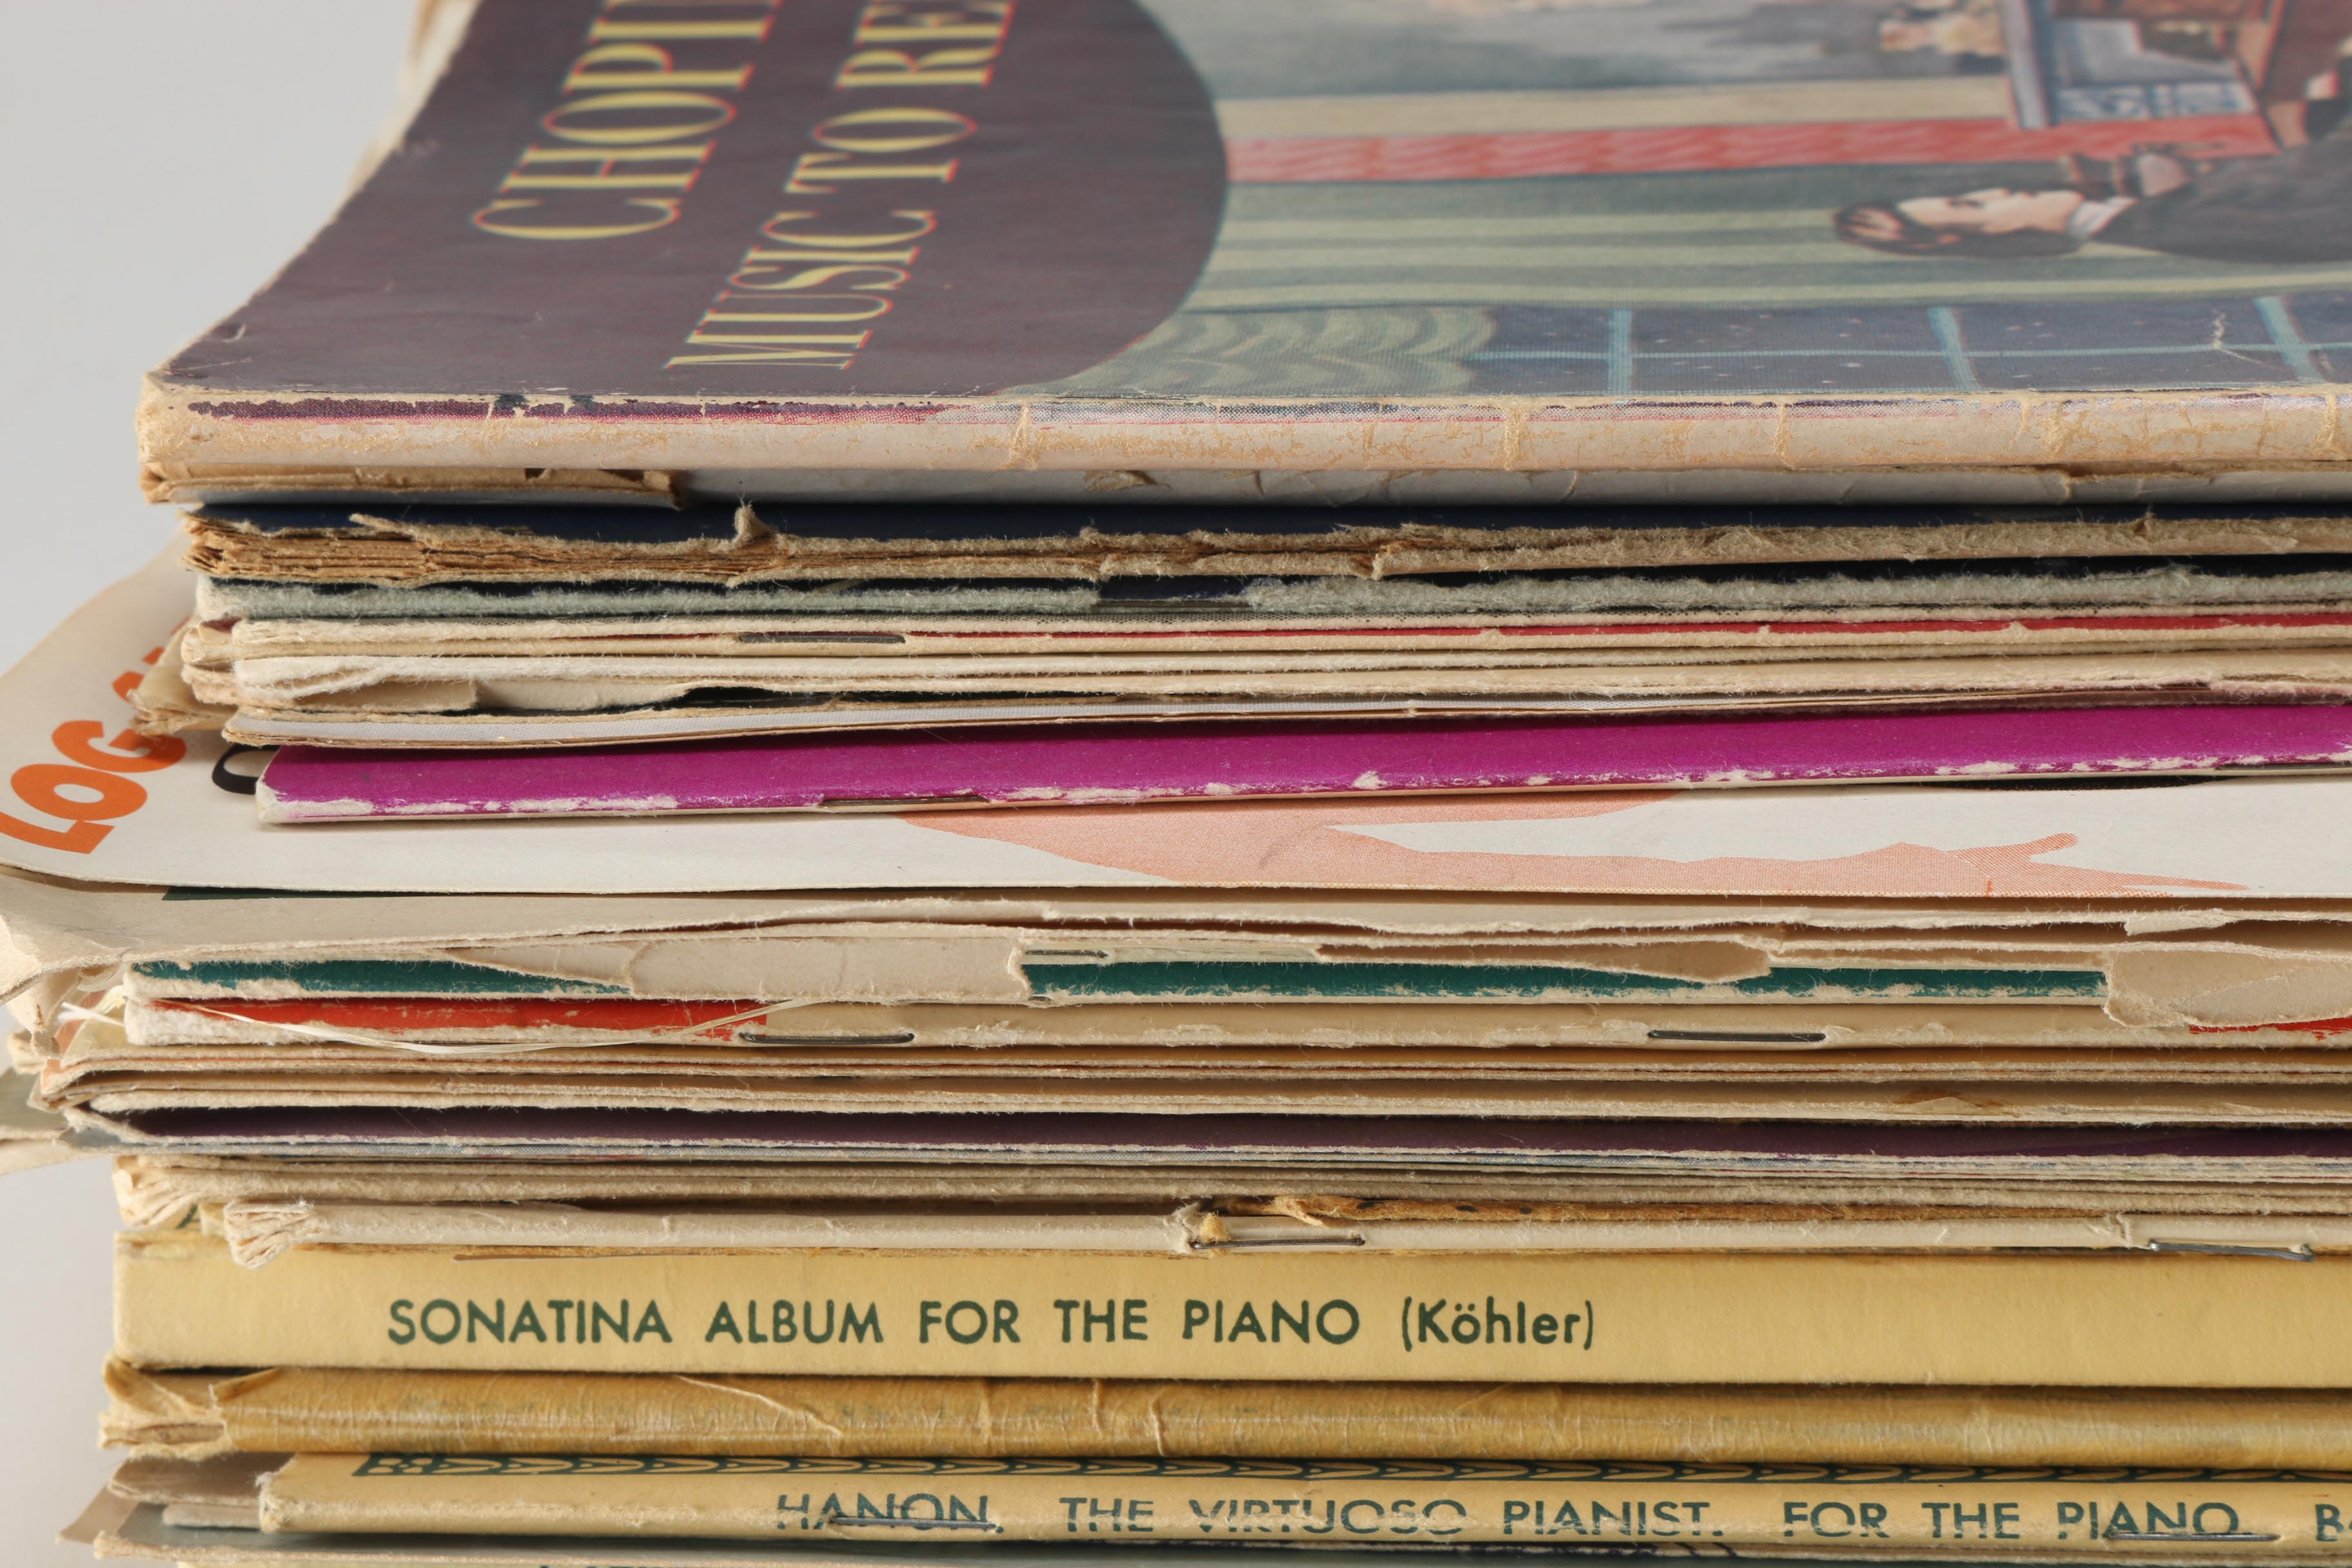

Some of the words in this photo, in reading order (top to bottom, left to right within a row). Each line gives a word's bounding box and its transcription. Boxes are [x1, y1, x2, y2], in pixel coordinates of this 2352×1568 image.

[472, 0, 780, 239] CHOPI
[784, 107, 977, 193] TO
[663, 210, 937, 369] MUSIC
[388, 1298, 672, 1345] SONATINA
[705, 1299, 884, 1344] ALBUM
[919, 1299, 1021, 1345] FOR
[1054, 1298, 1148, 1343] THE
[1182, 1298, 1360, 1345] PIANO
[1402, 1295, 1594, 1352] (Köhler)
[777, 1493, 1004, 1534] HANON.
[1059, 1497, 1154, 1533] THE
[1188, 1499, 1468, 1535] VIRTUOSO
[1503, 1500, 1723, 1537] PIANIST.
[1784, 1501, 1890, 1538] FOR
[1921, 1502, 2021, 1539] THE
[2057, 1501, 2240, 1541] PIANO
